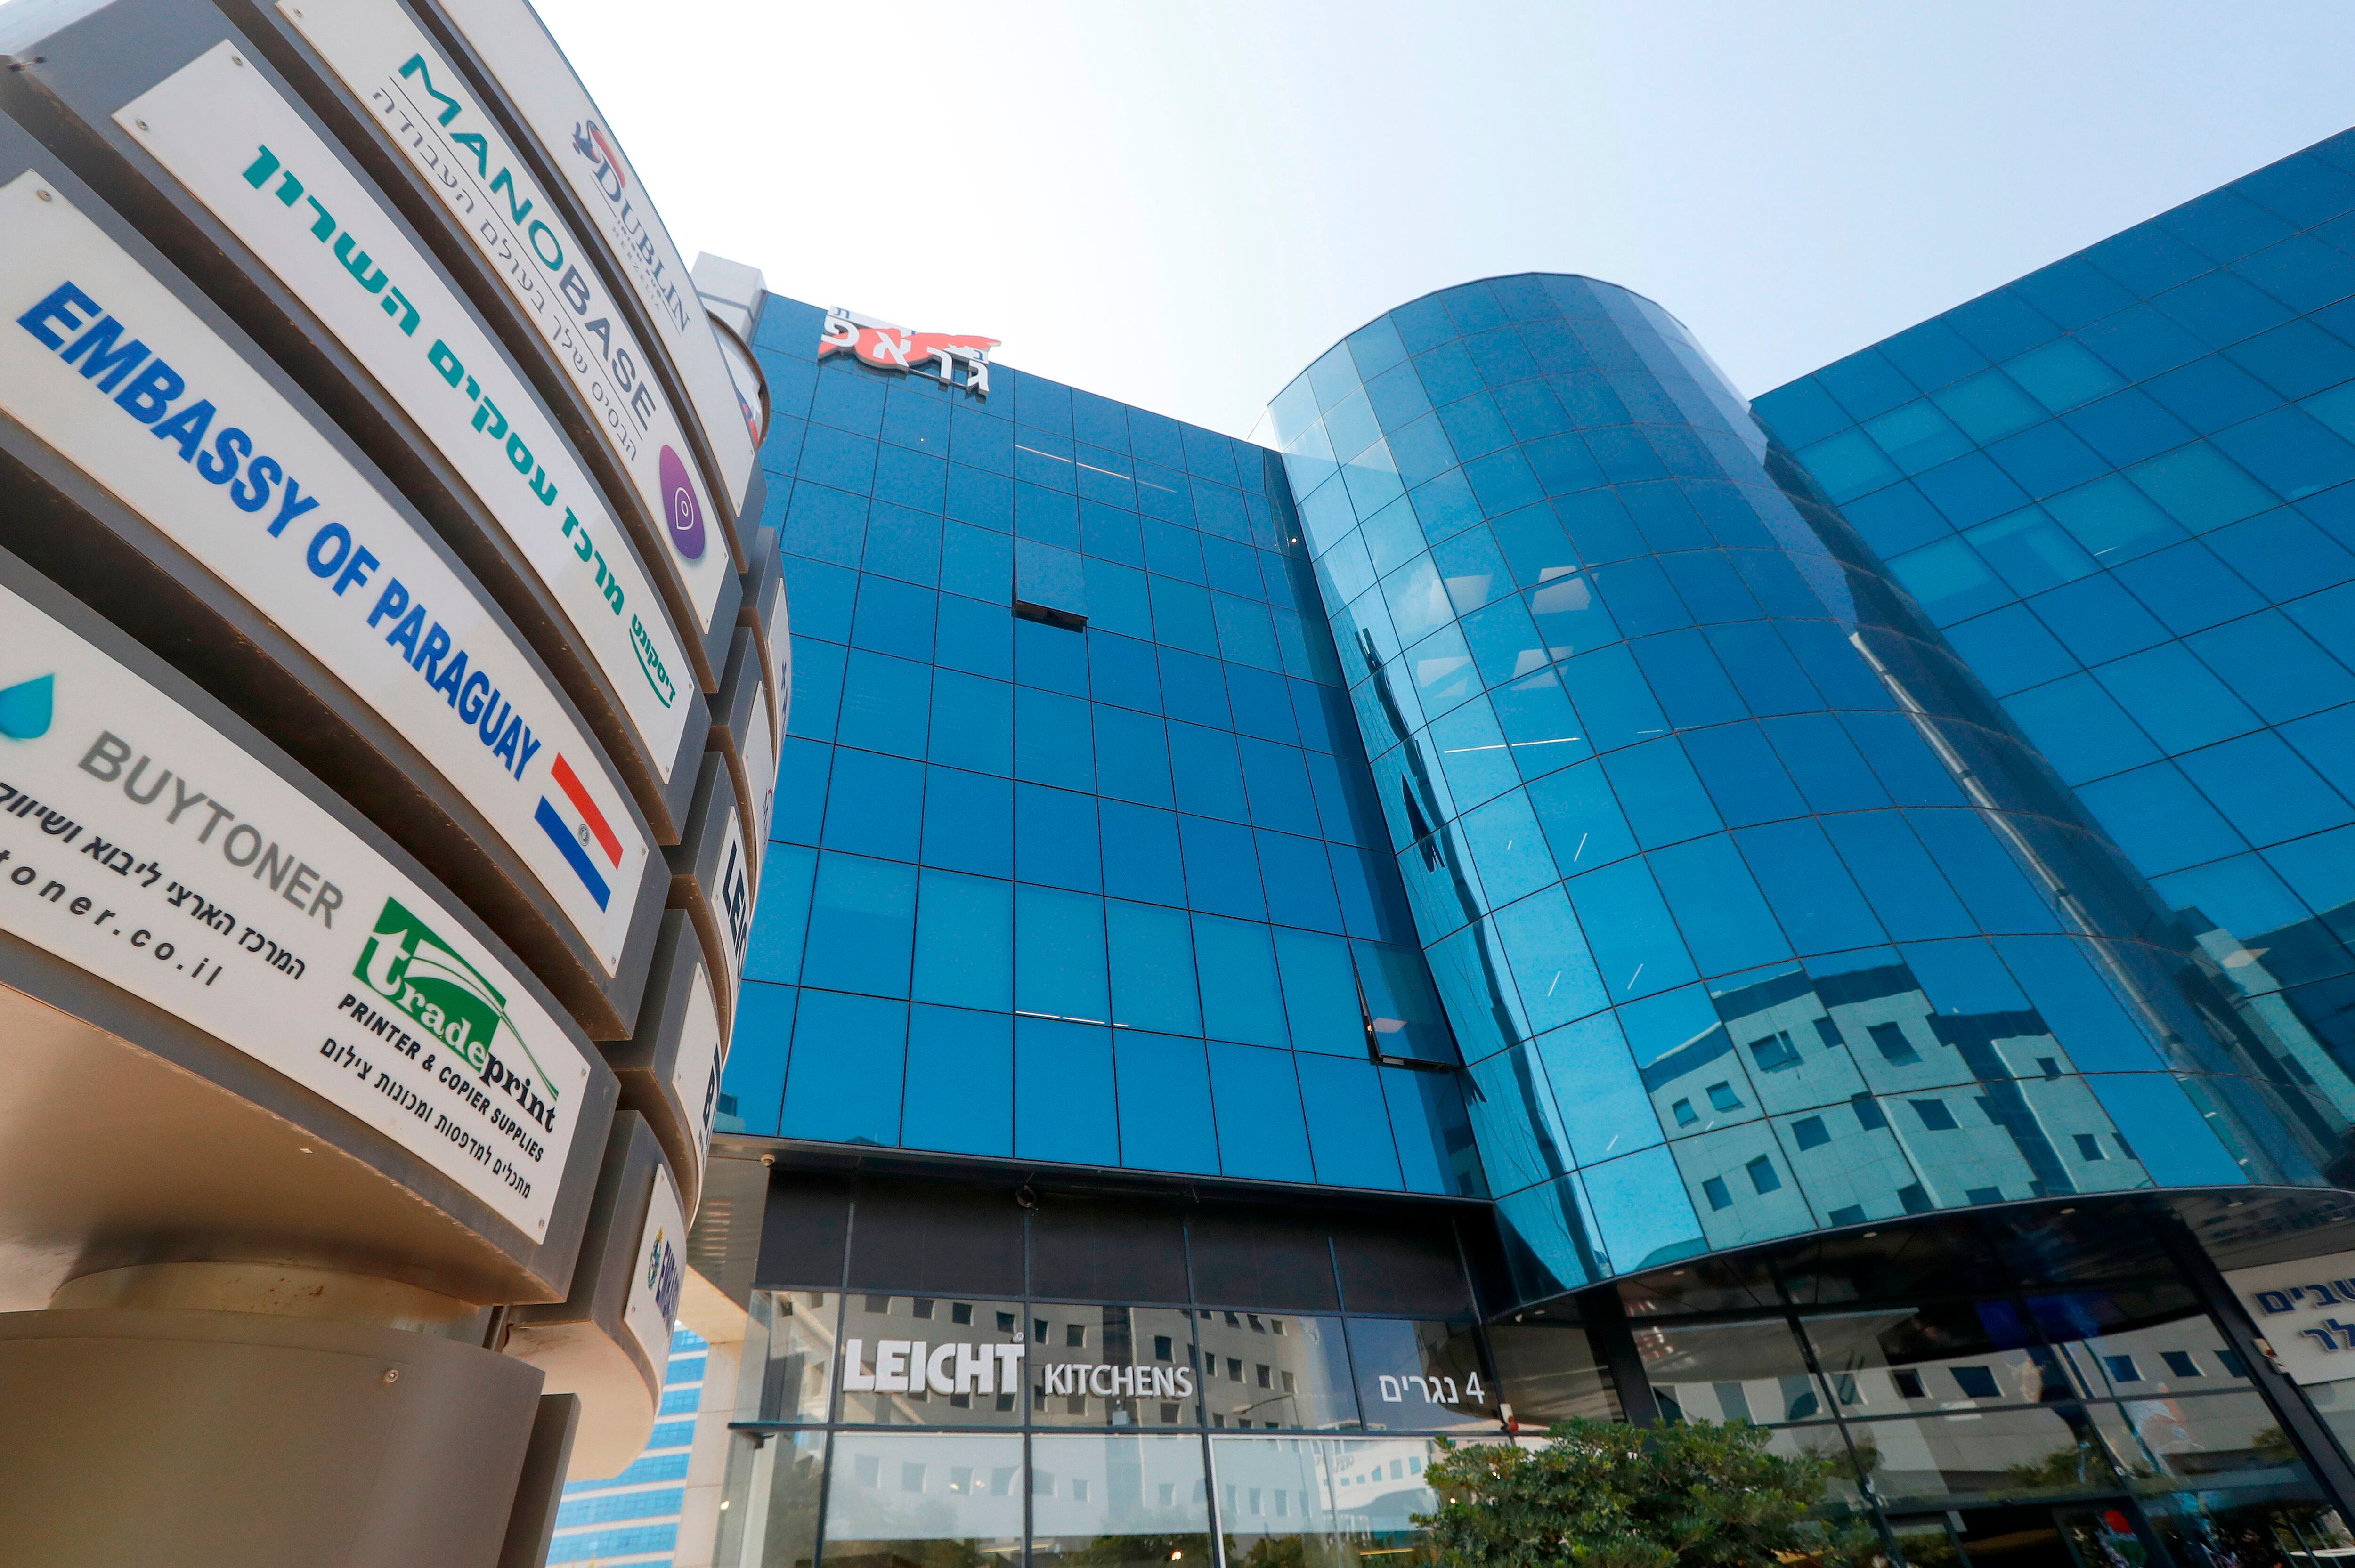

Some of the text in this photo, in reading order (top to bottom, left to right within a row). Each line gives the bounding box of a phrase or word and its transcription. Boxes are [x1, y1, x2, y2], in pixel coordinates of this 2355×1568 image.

[372, 87, 637, 462] הבסיס שלך בעולם העבודה
[398, 53, 657, 432] MANOBASE
[592, 154, 690, 332] DUBLIN
[242, 144, 676, 703] דיסקונט מרכז עסקים השרון
[16, 281, 319, 539] EMBASSY
[307, 522, 380, 597] OF
[367, 577, 541, 781] PARAGUAY
[78, 730, 344, 930] BUYTONER
[81, 835, 162, 889] ליבוא
[167, 882, 236, 935] הארצי
[237, 926, 306, 980] המרכז
[365, 929, 558, 1133] tradeprint
[320, 1037, 531, 1198] מתכלים למדפסות ומכונות צילום
[338, 994, 544, 1162] PRINTER & COPIER SUPPLIES
[1044, 1362, 1193, 1399] KITCHENS
[1379, 1371, 1485, 1404] 4 נגרים
